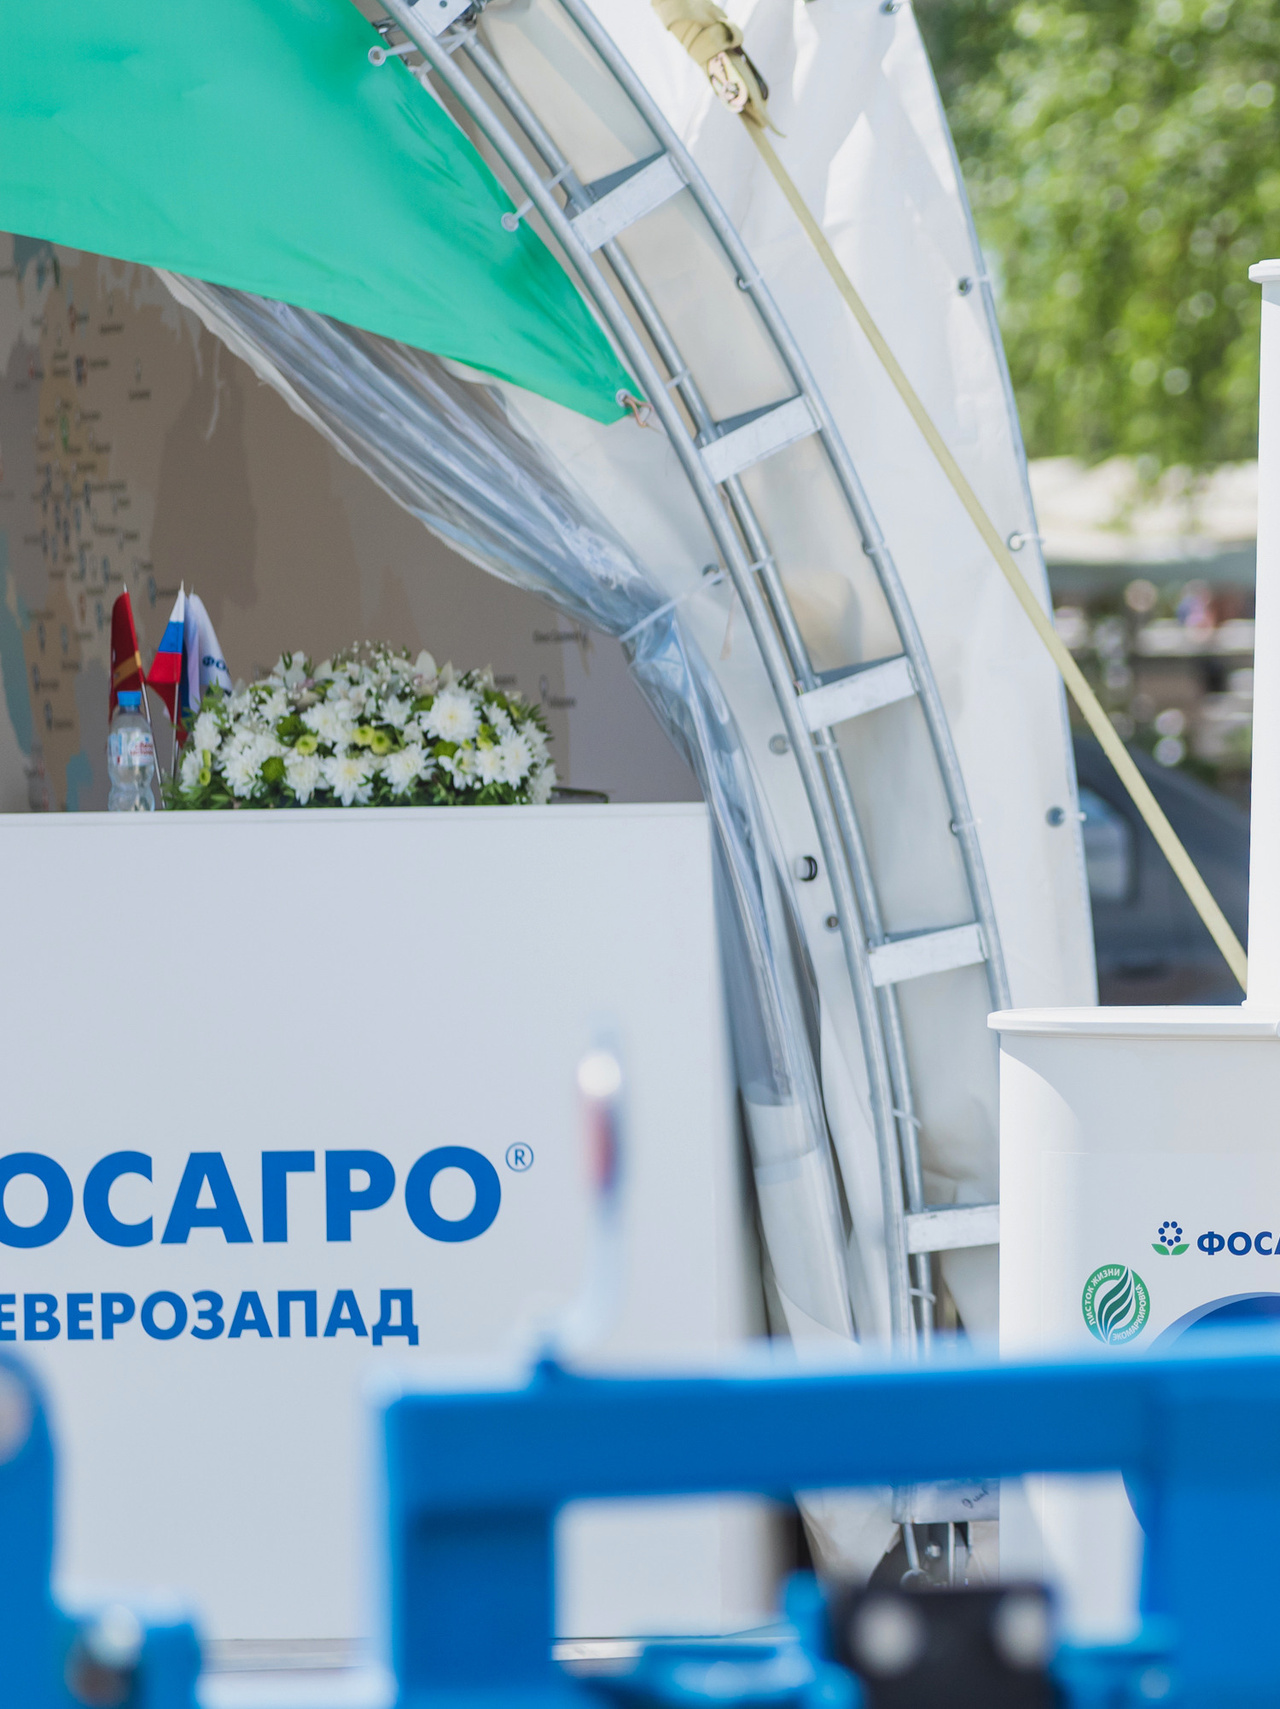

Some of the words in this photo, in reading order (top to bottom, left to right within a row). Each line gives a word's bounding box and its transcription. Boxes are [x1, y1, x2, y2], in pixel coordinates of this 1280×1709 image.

[0, 1142, 535, 1249] ОСАГРО®
[0, 1288, 420, 1346] ЕВЕРОЗАПАД
[1084, 1285, 1096, 1326] ЛИСТОК
[1090, 1268, 1121, 1287] ЖИЗНИ
